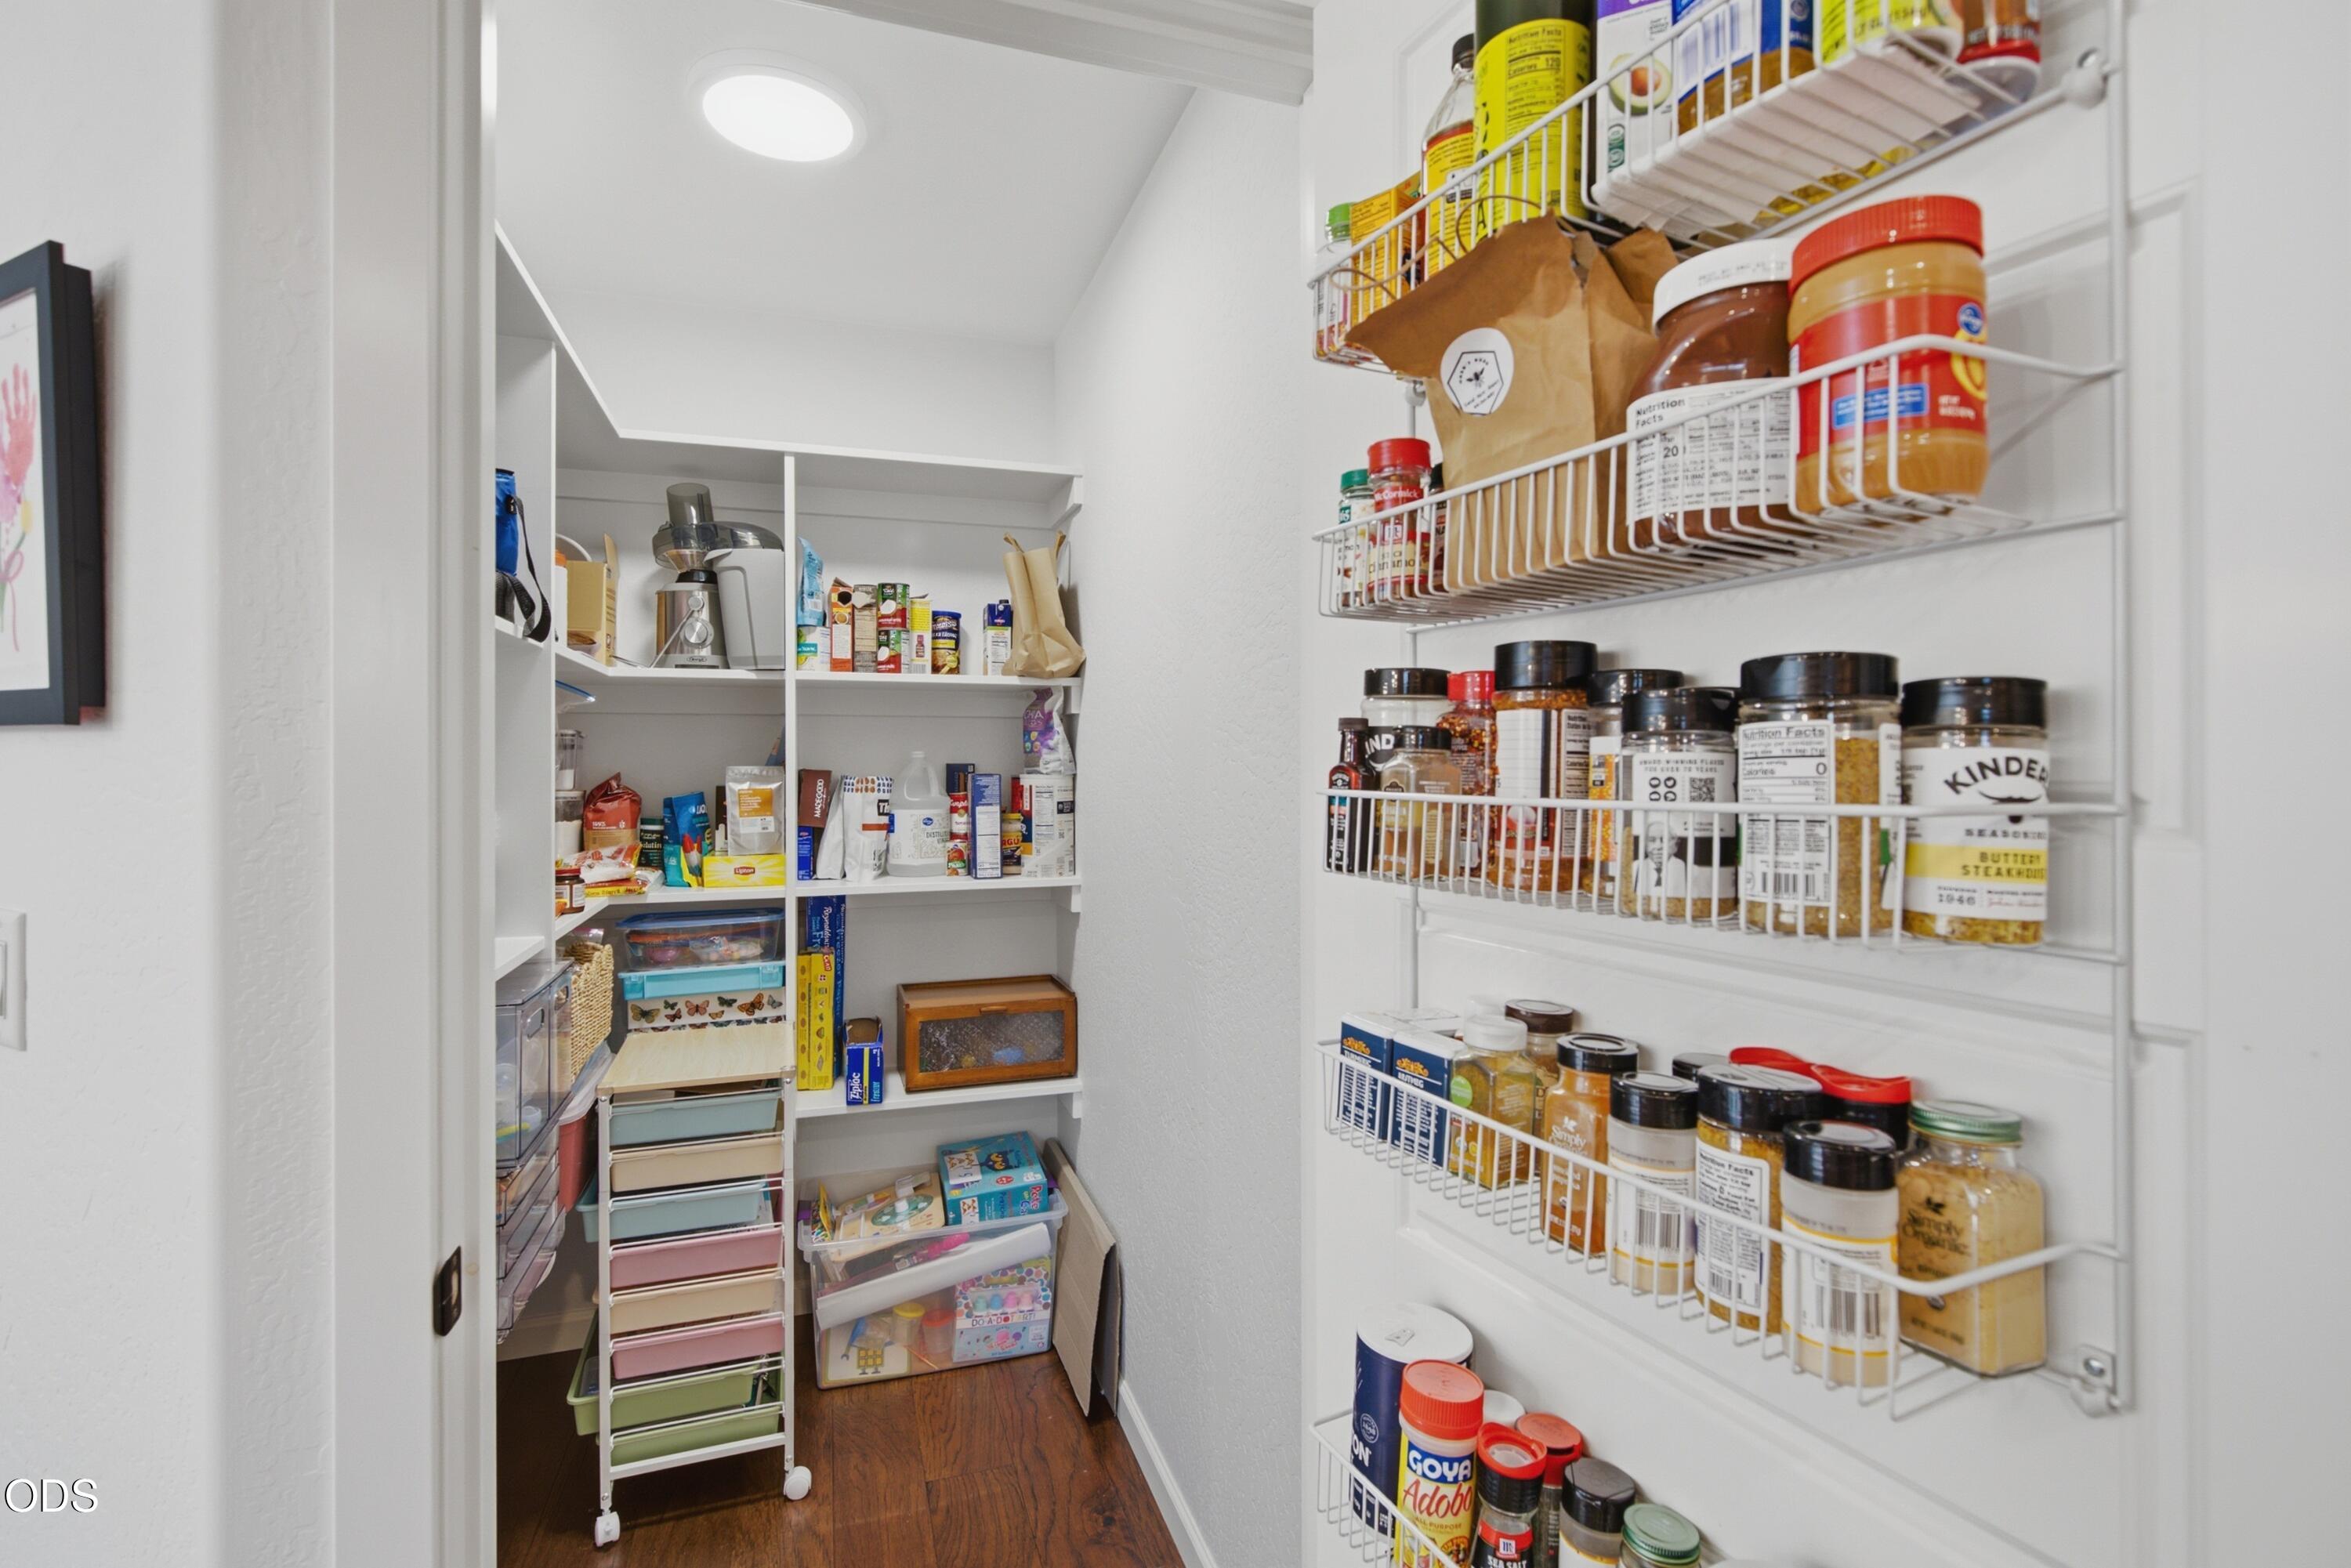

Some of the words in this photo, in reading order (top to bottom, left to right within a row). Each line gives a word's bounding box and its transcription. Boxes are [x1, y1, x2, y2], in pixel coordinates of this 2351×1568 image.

[1636, 398, 1686, 417] Nutrition
[1636, 415, 1664, 429] Facts
[849, 1072, 862, 1101] Ziploc
[1408, 1449, 1472, 1483] GOYA
[1403, 1478, 1473, 1519] Adobo
